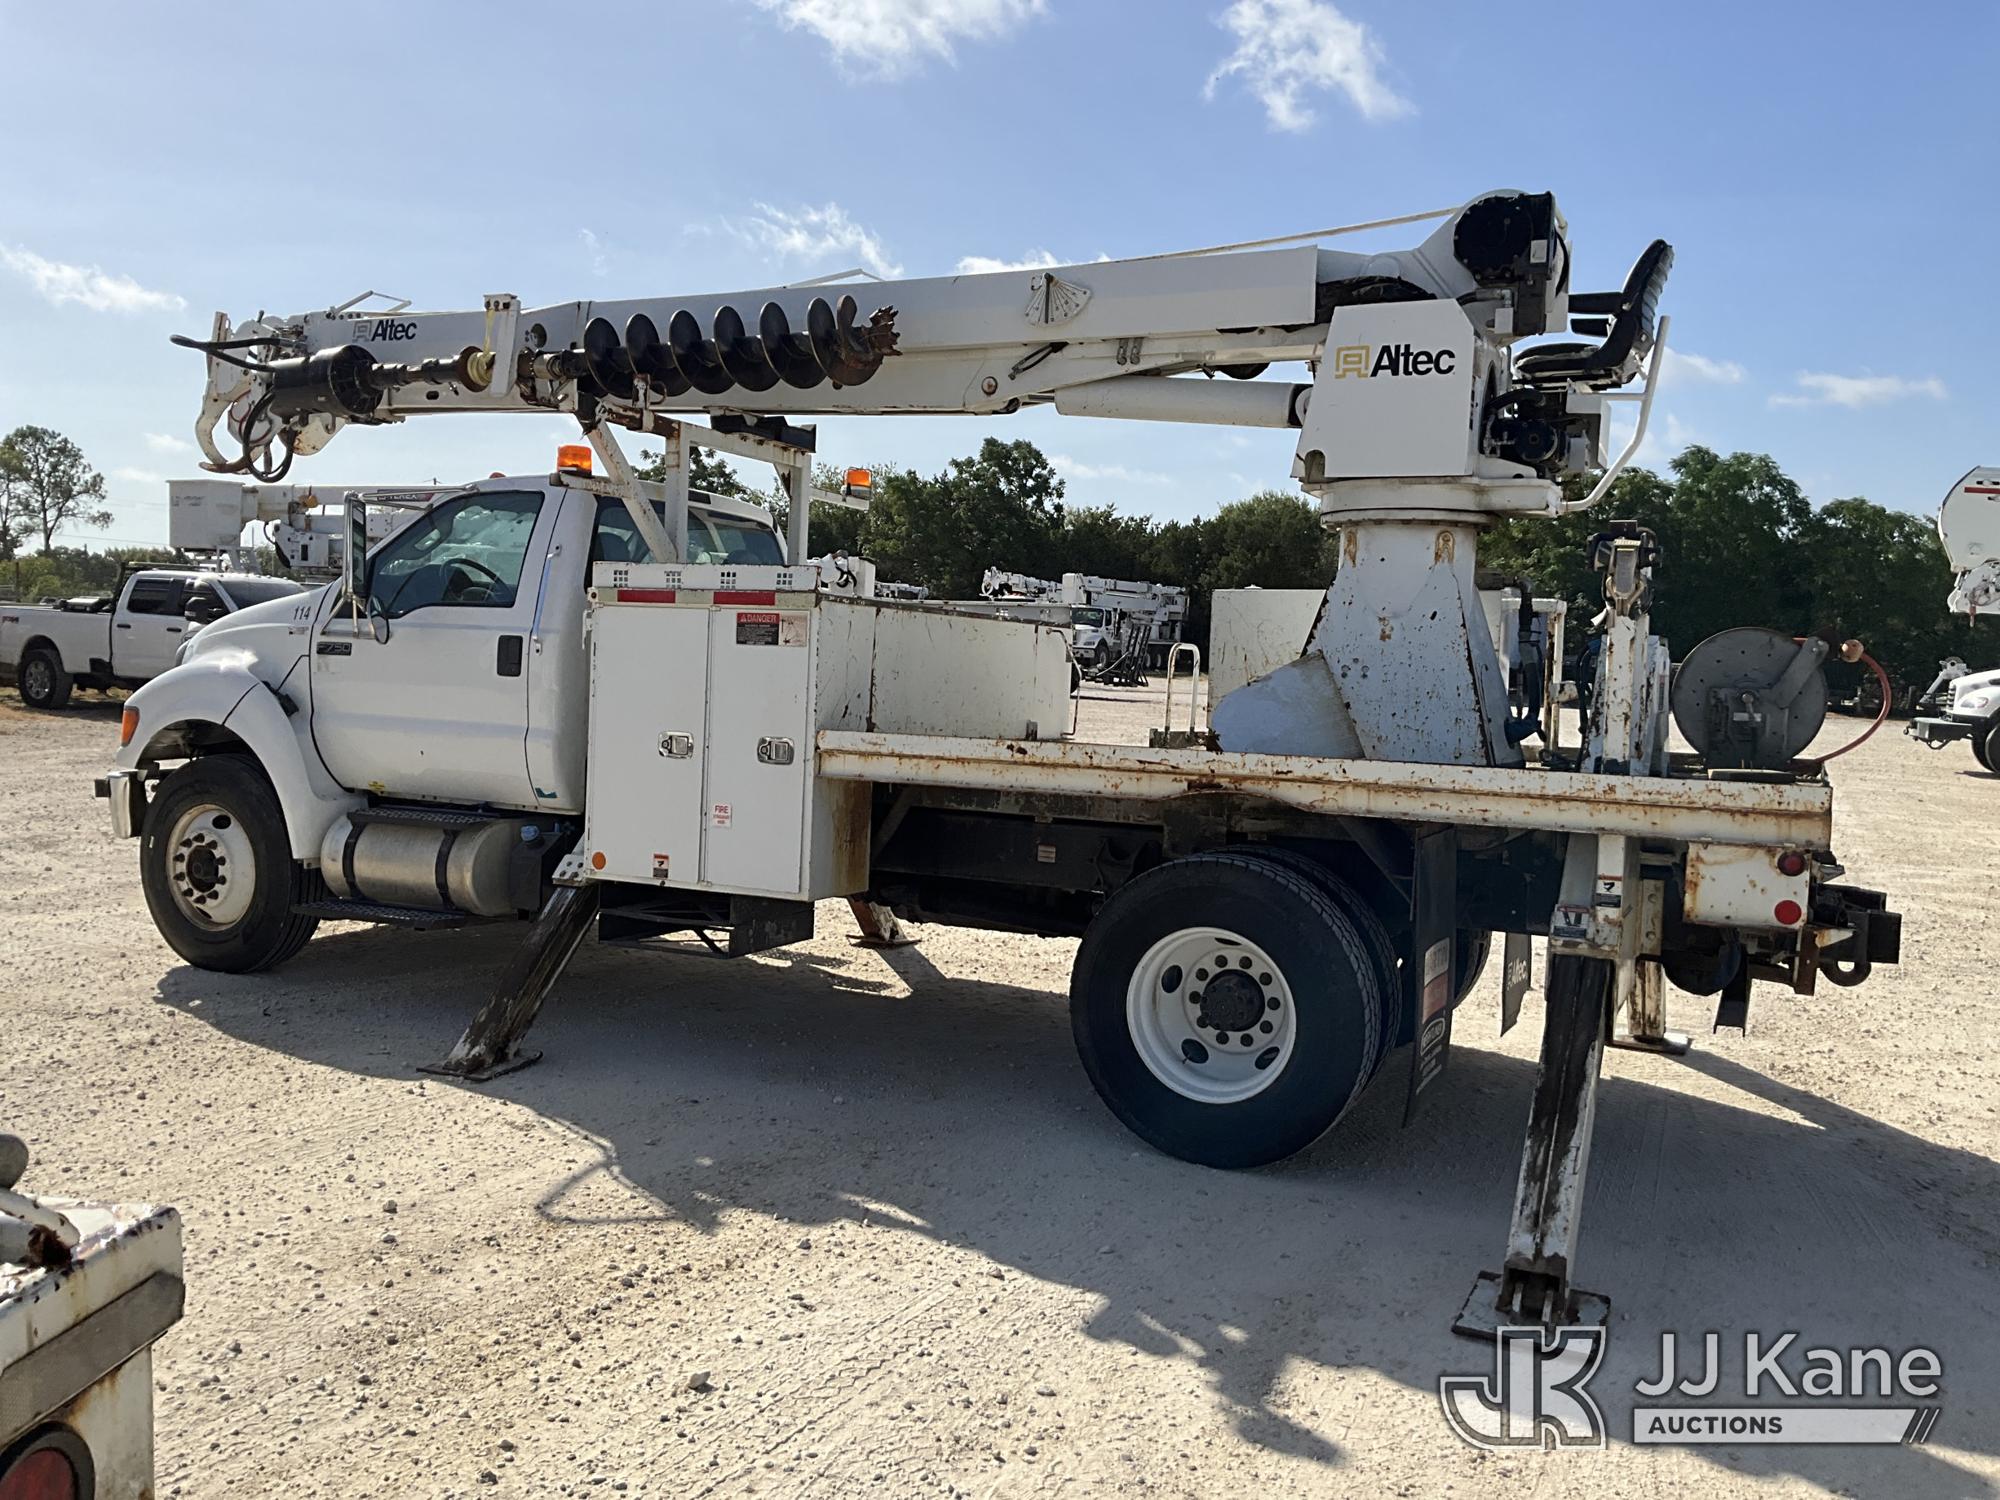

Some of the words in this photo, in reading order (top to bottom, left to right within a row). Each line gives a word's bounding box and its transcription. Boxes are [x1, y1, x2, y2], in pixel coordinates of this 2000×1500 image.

[371, 319, 417, 341] Altec
[1370, 344, 1455, 377] Altec
[294, 606, 311, 620] 114
[747, 614, 777, 623] DANGER
